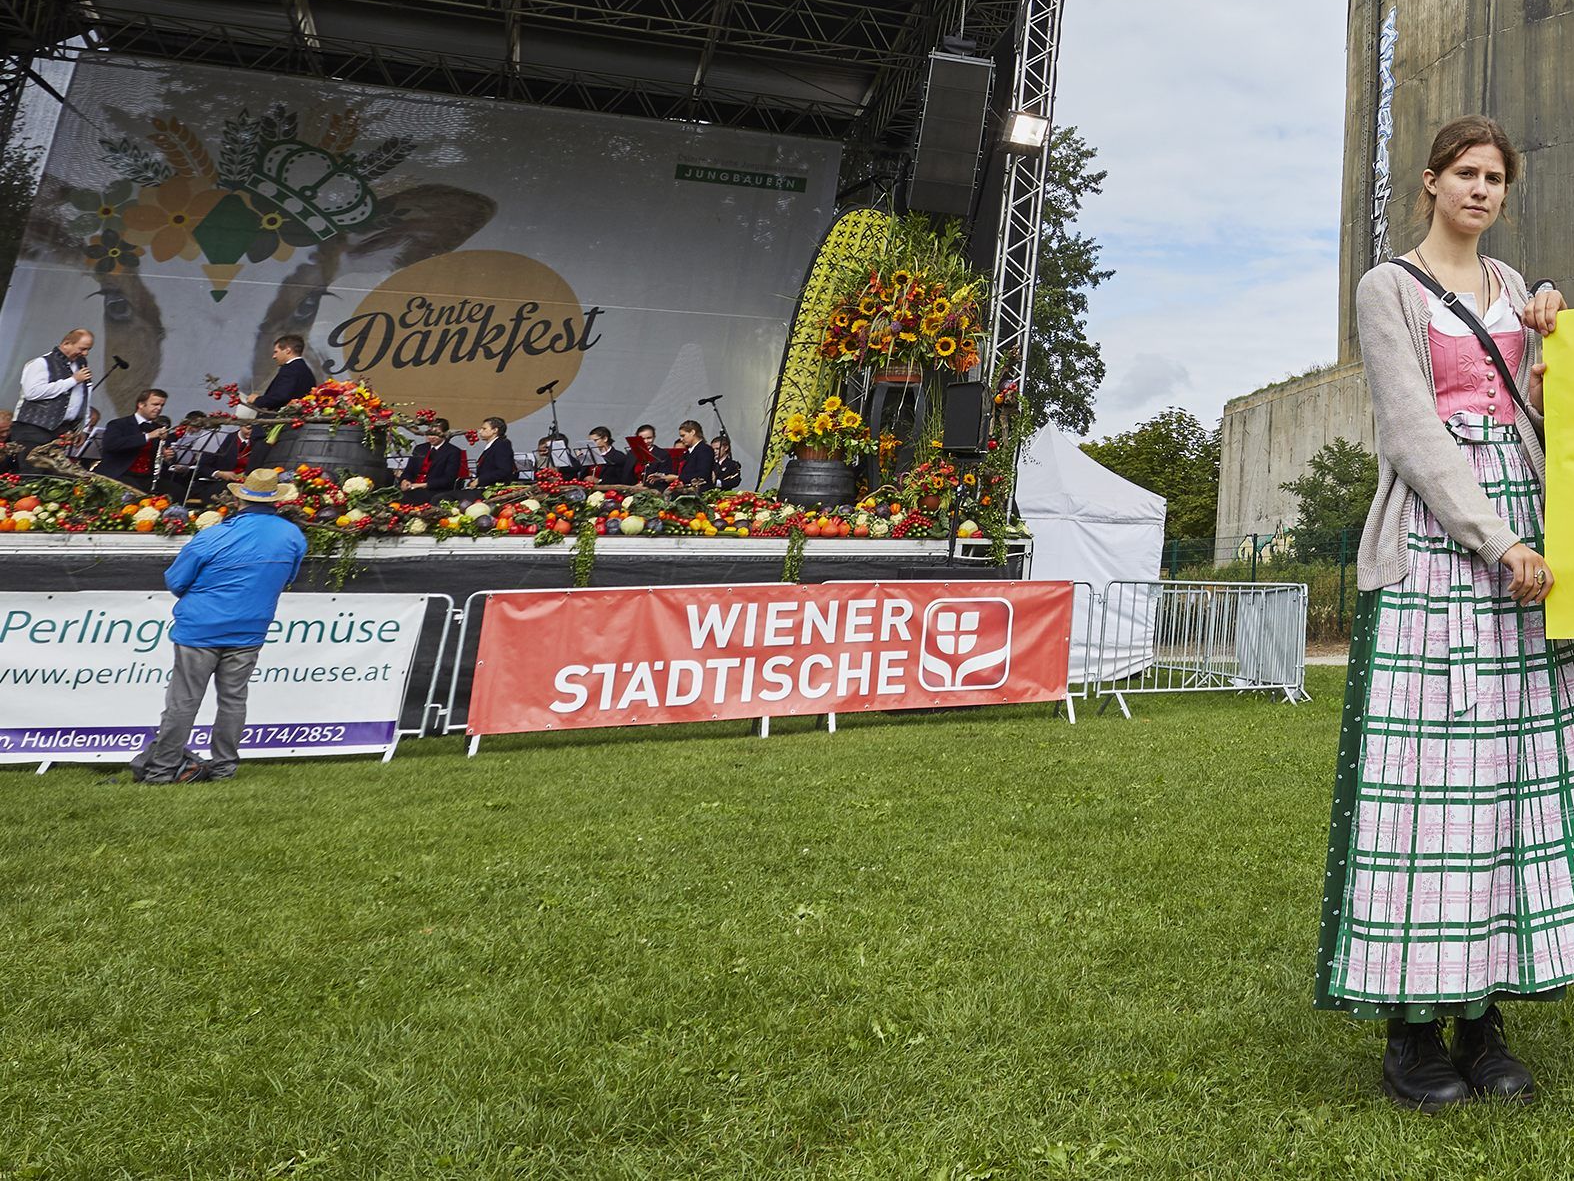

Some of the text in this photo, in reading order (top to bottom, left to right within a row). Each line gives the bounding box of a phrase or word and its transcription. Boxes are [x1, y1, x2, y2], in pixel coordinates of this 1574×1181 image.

[684, 169, 796, 189] JUNGBAUERN
[399, 296, 487, 329] Ernte
[322, 302, 605, 375] Dankfest
[0, 609, 400, 653] Perling emüse
[686, 599, 914, 650] WIENER
[548, 650, 908, 713] STÄDTISCHE
[20, 730, 146, 750] Huldenweg
